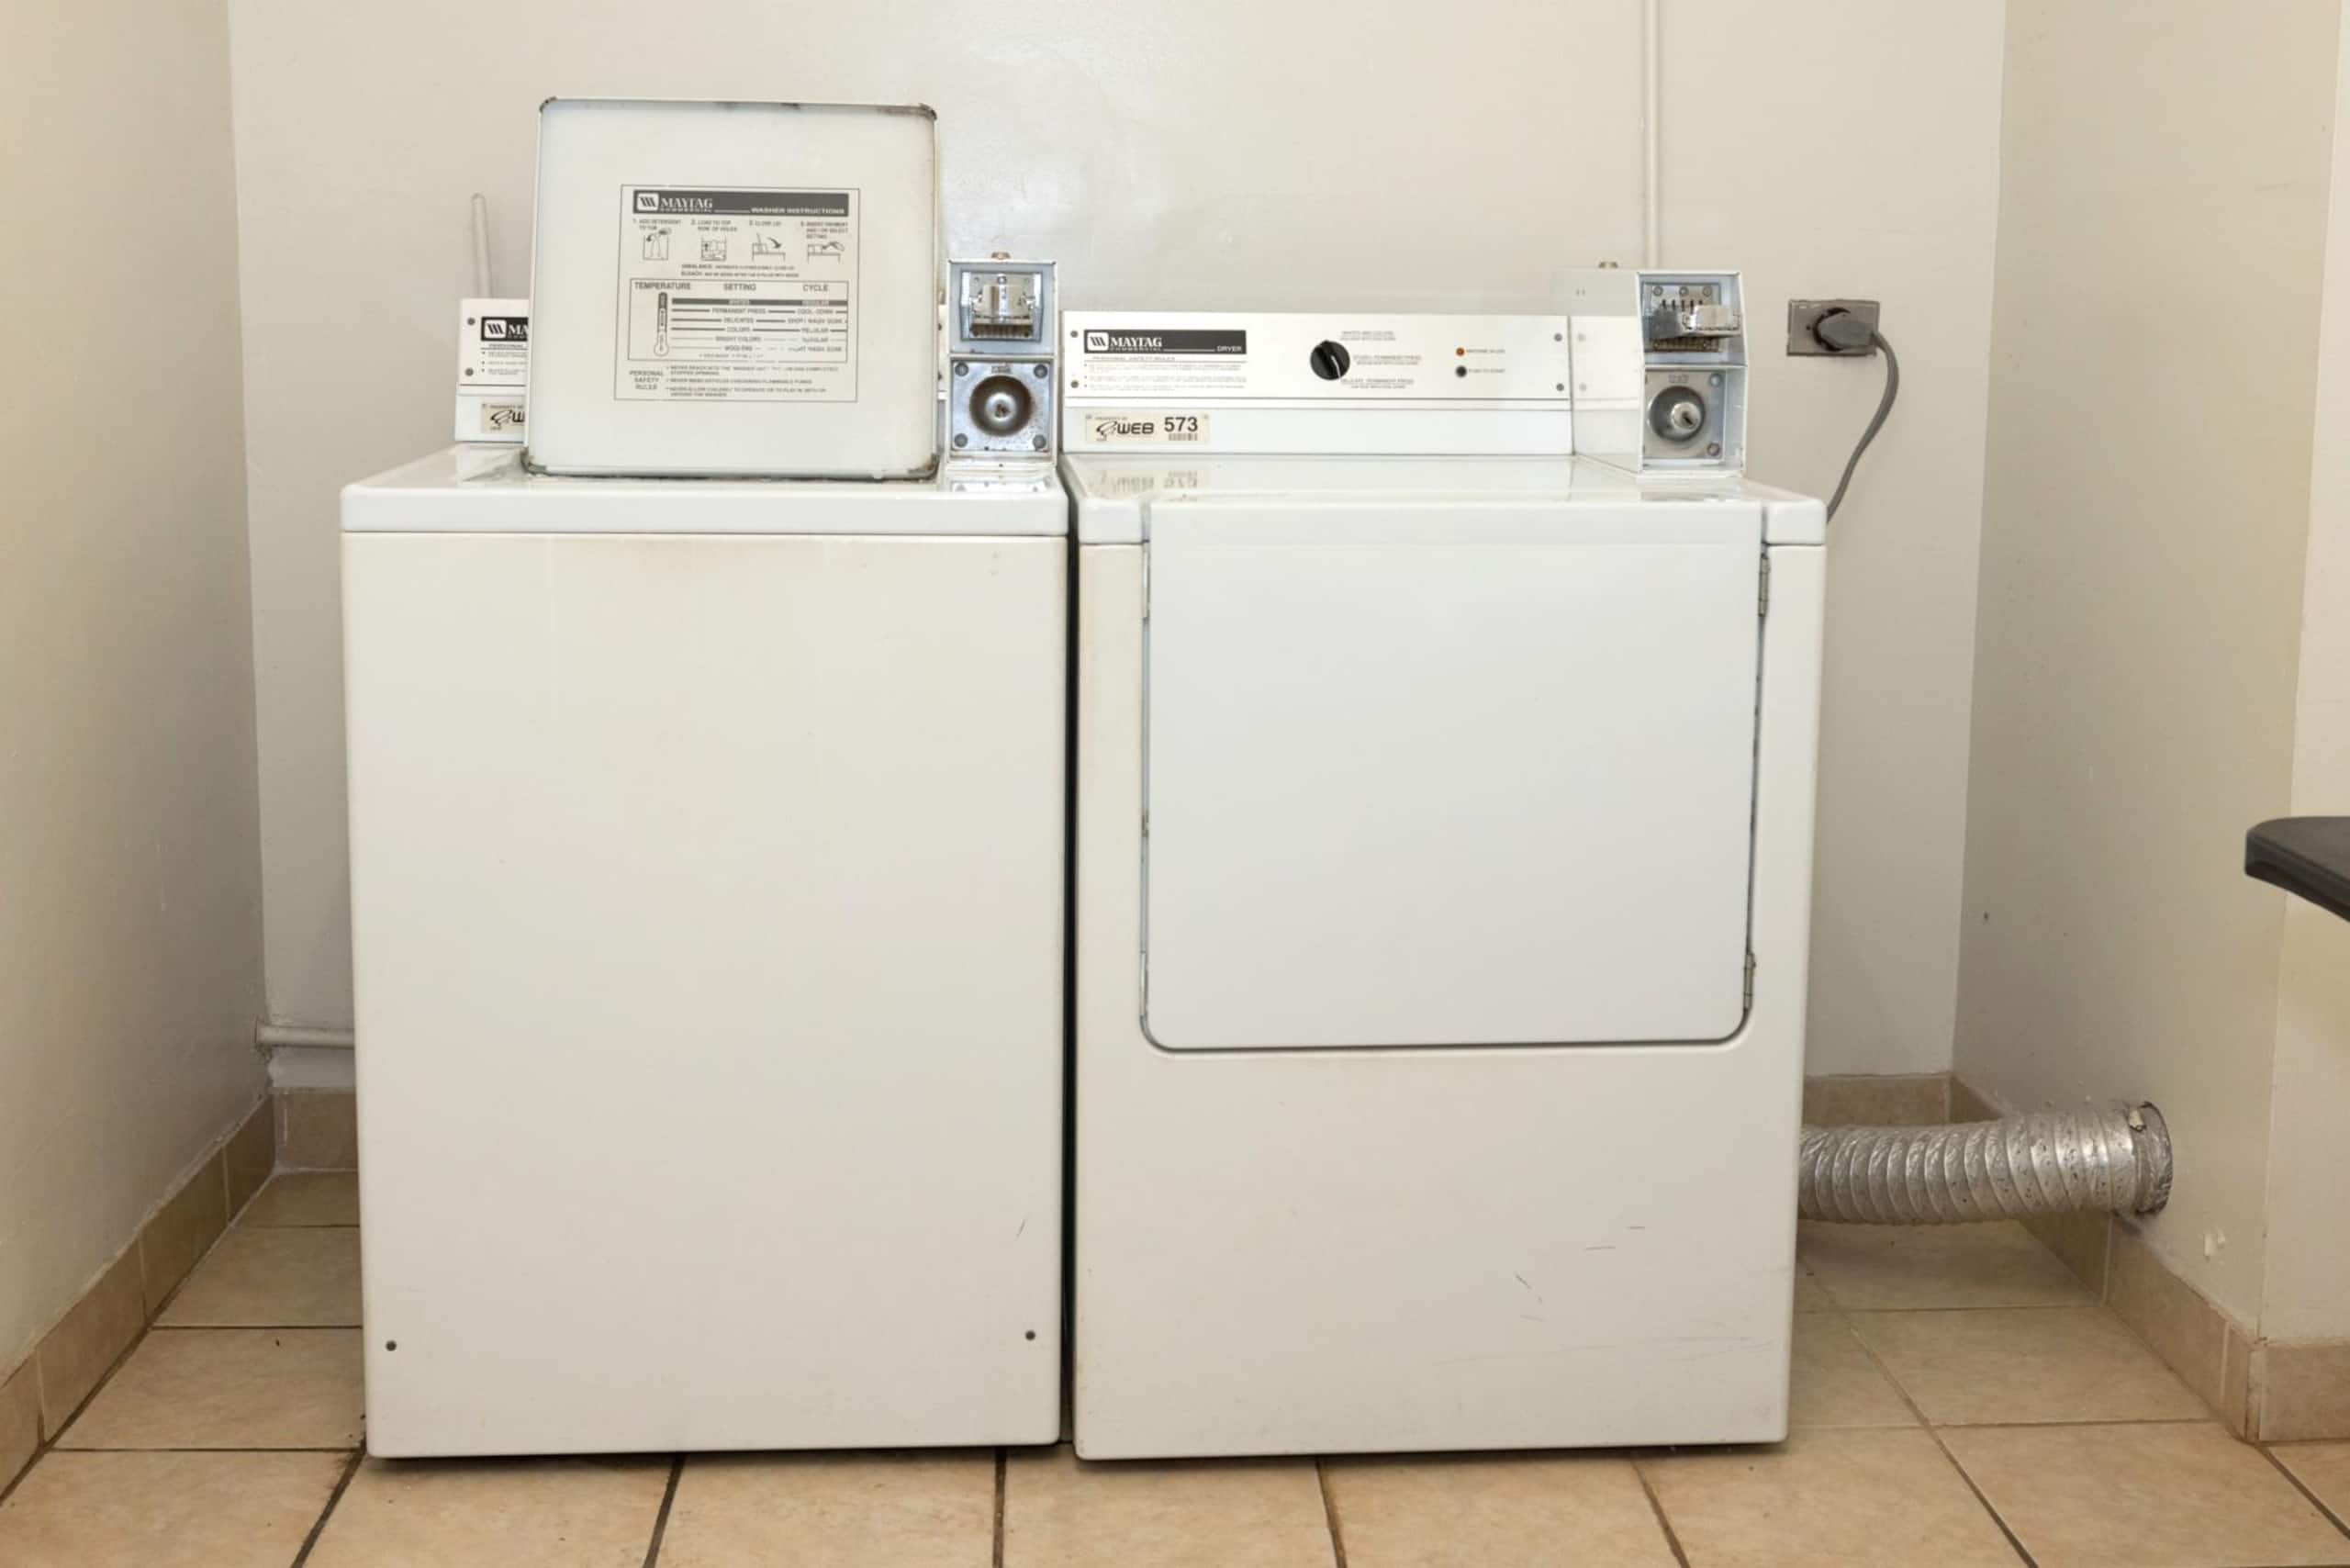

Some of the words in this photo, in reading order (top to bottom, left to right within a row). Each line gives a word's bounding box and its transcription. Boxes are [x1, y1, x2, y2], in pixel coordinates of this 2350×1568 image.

[660, 196, 713, 208] MAYTAG
[634, 282, 691, 291] TEMPERATURE
[723, 283, 756, 291] SETTING
[802, 283, 829, 292] CYCLE
[1110, 336, 1163, 347] MAYTAG
[1116, 422, 1155, 434] WEB
[1163, 416, 1199, 432] 573
